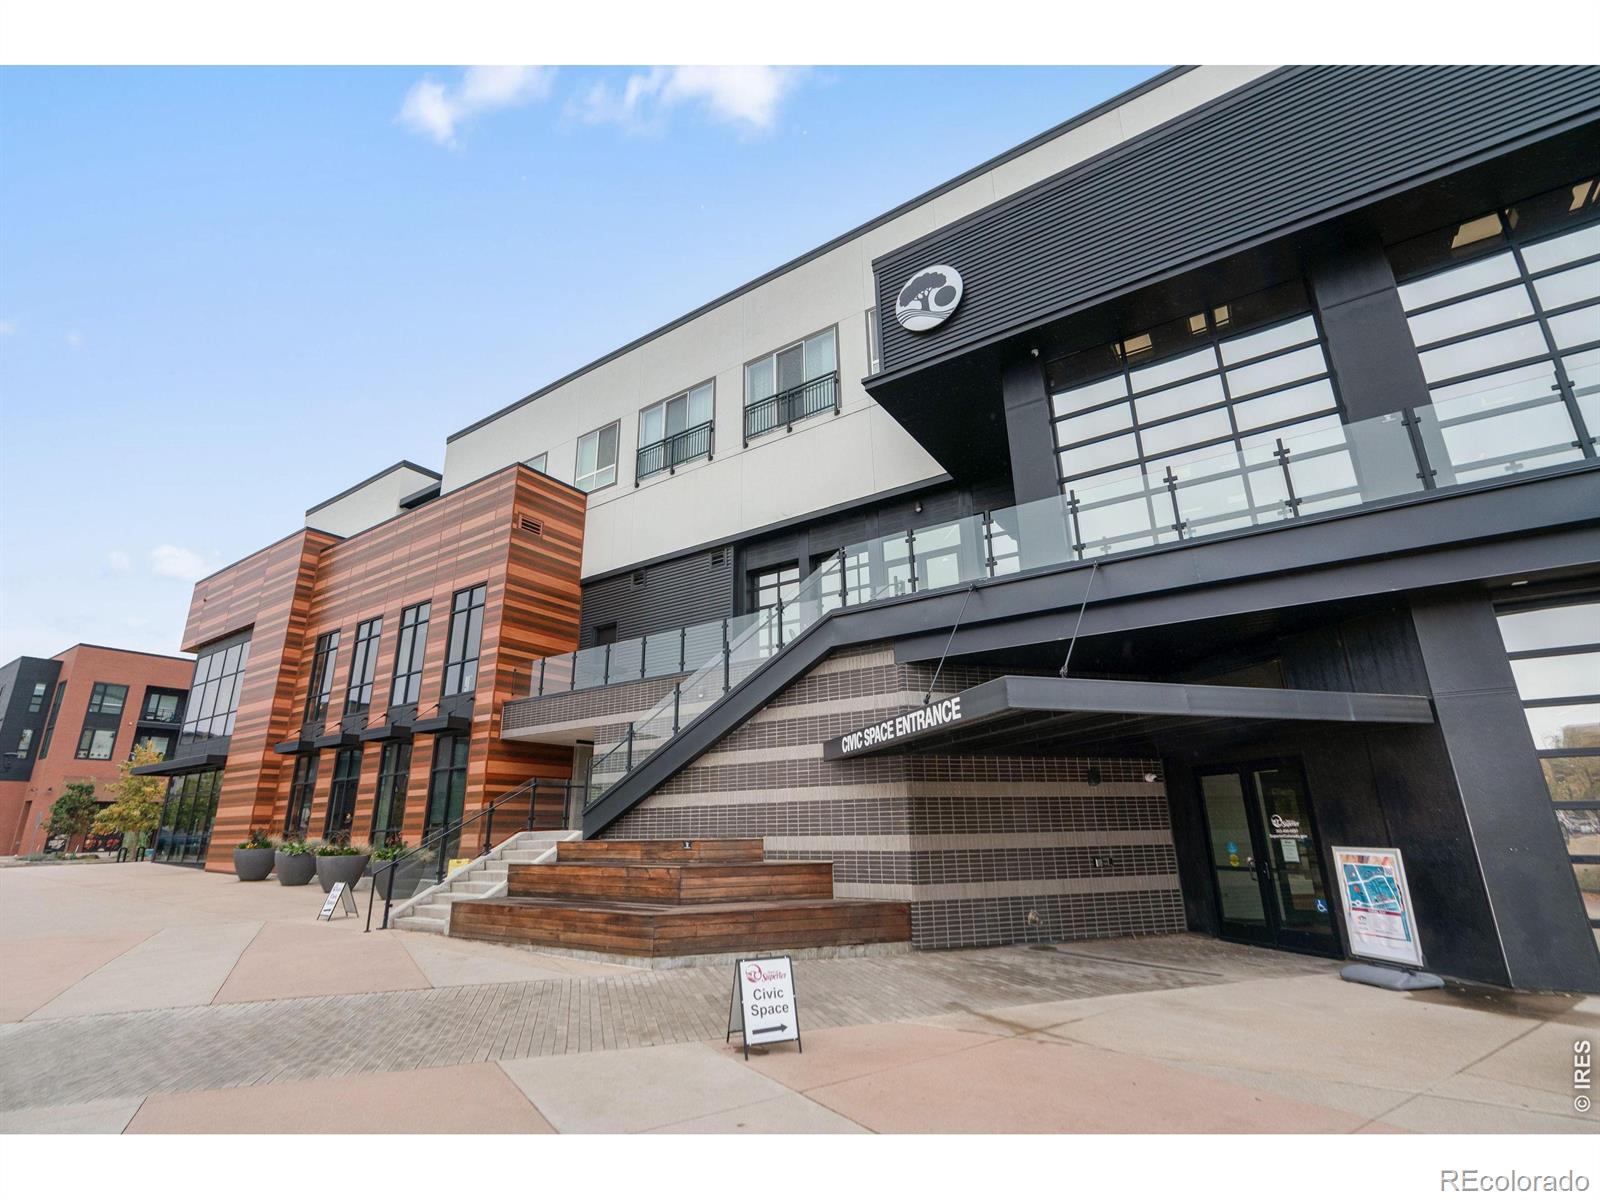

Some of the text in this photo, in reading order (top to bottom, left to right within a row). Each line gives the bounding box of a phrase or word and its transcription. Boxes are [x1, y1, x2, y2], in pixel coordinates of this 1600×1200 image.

[841, 696, 962, 753] CIVIC SPACE ENTRANCE
[753, 987, 784, 1001] Civic
[750, 1003, 789, 1019] Space
